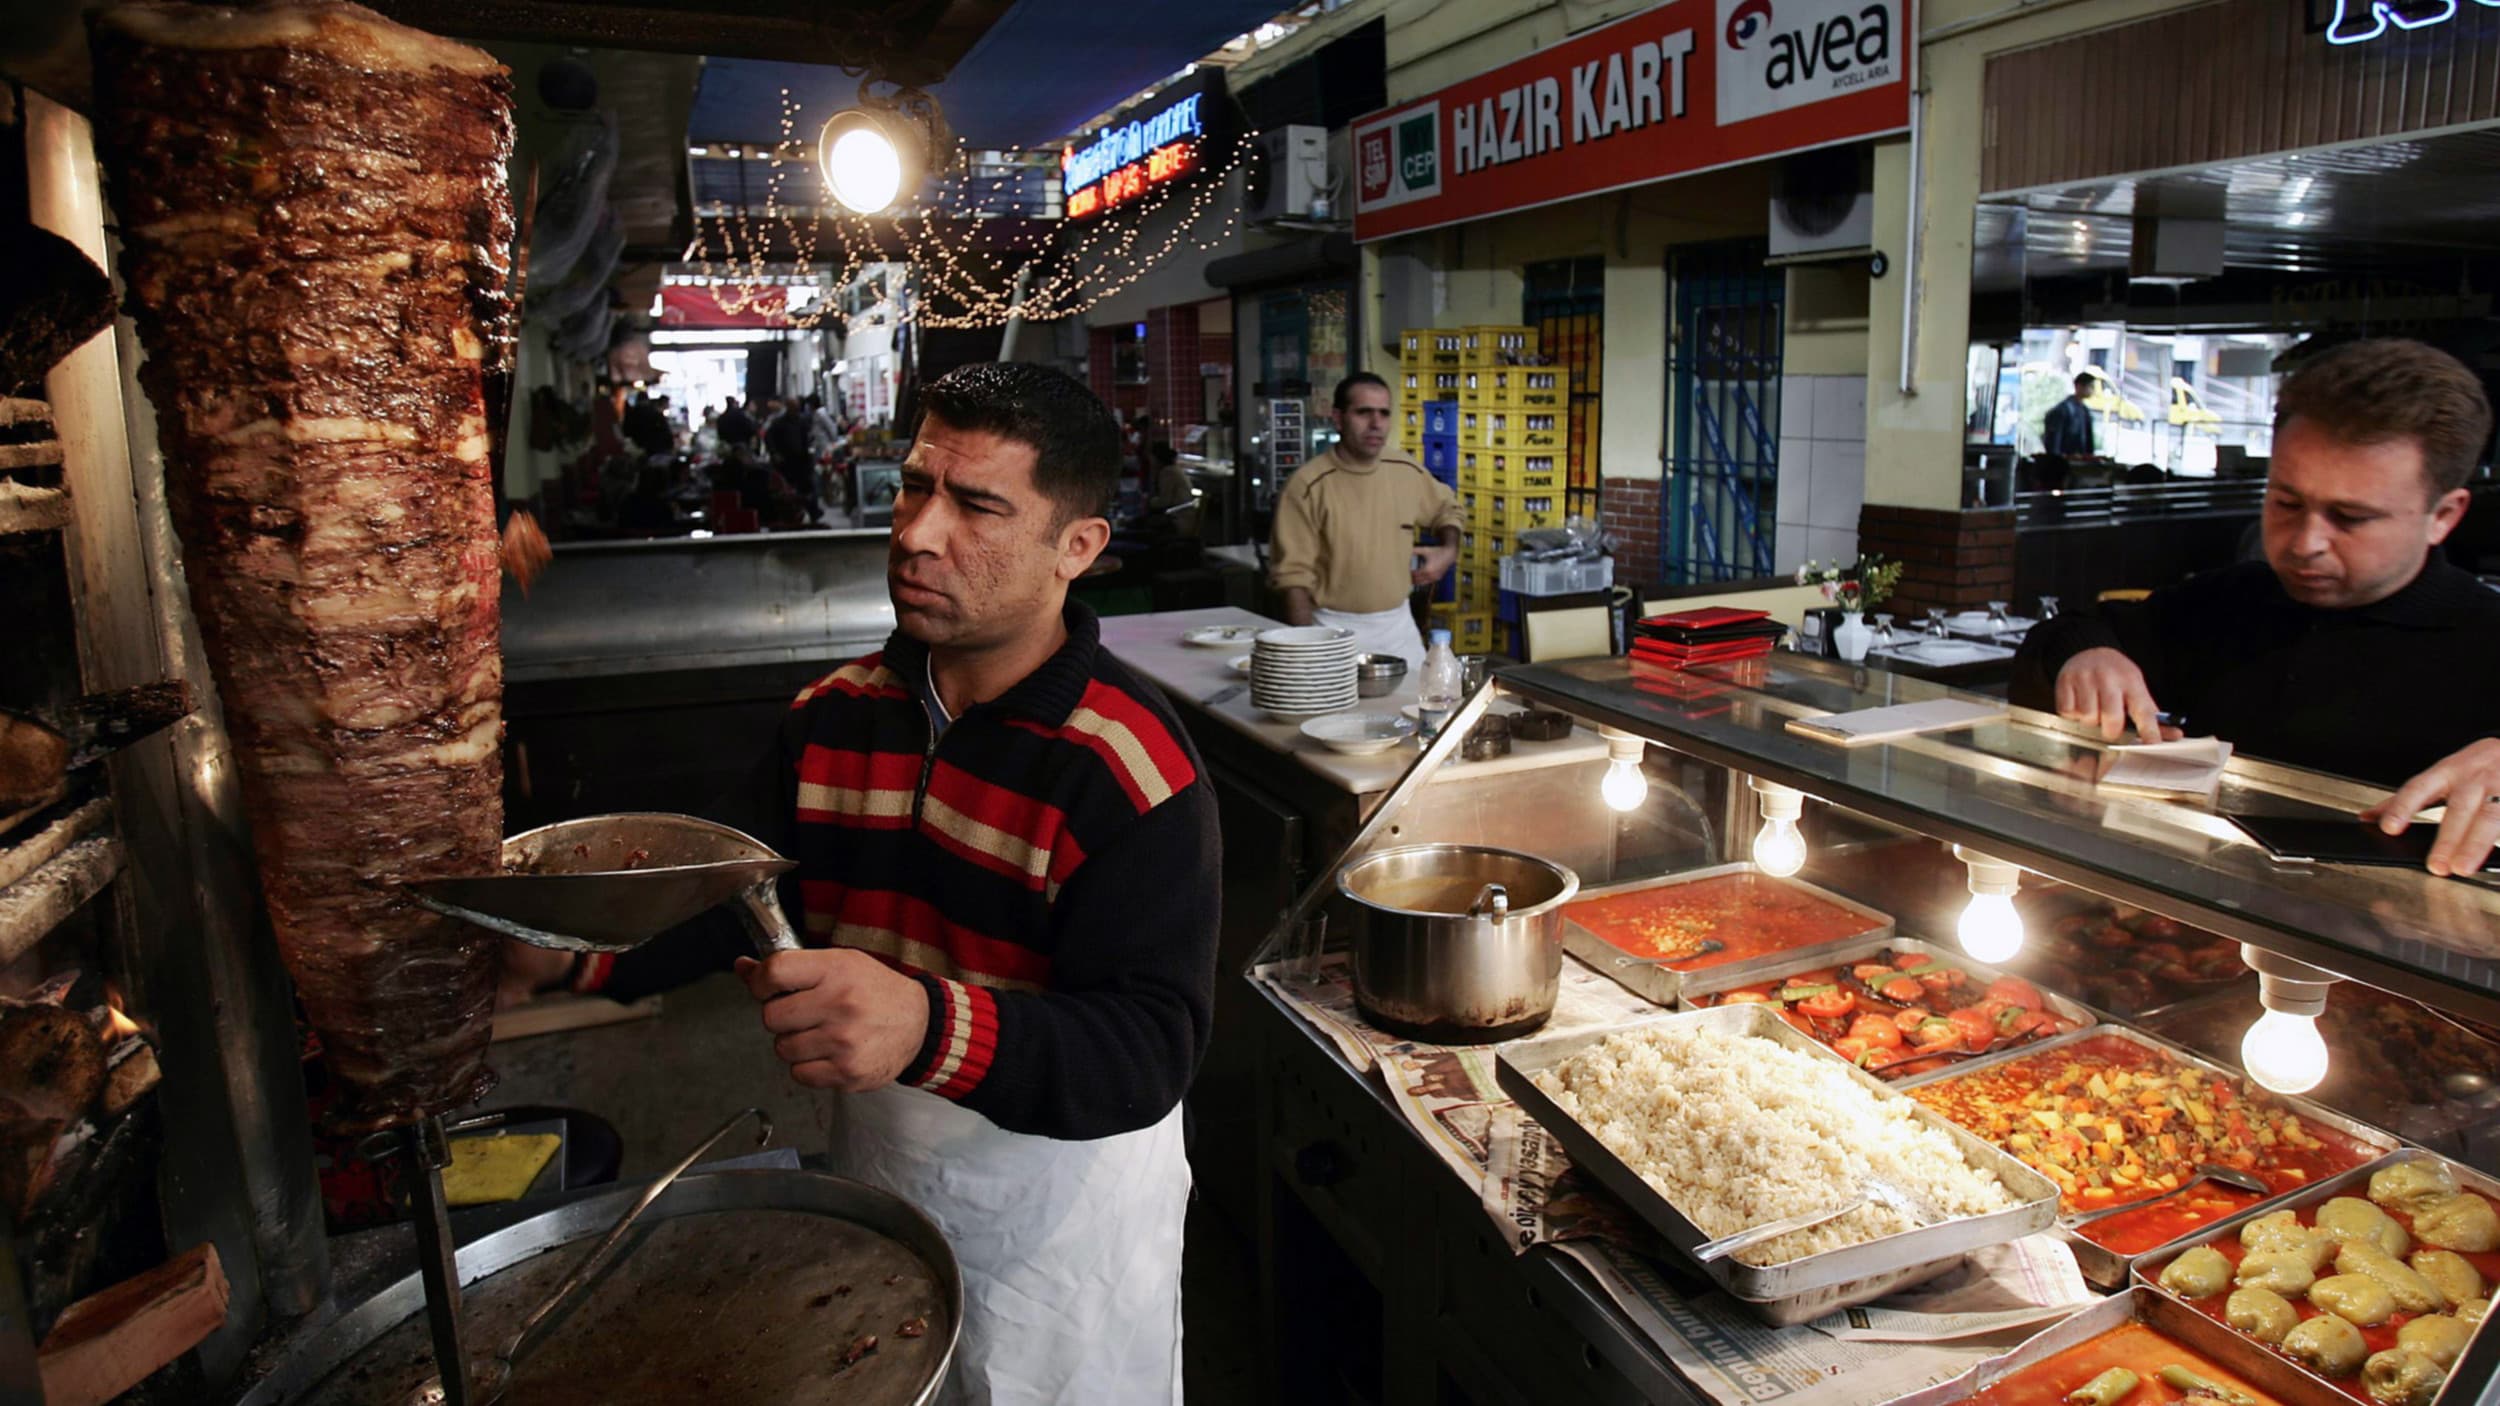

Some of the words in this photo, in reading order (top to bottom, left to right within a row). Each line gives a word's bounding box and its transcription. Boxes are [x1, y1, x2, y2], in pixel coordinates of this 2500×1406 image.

[1765, 3, 1890, 90] avea
[1832, 71, 1865, 89] AYCELL
[1868, 64, 1890, 79] ARIA
[1453, 77, 1561, 175] HAZIR
[1572, 28, 1695, 143] KART
[1403, 151, 1434, 179] CEP
[1706, 1335, 1788, 1402] Benim
